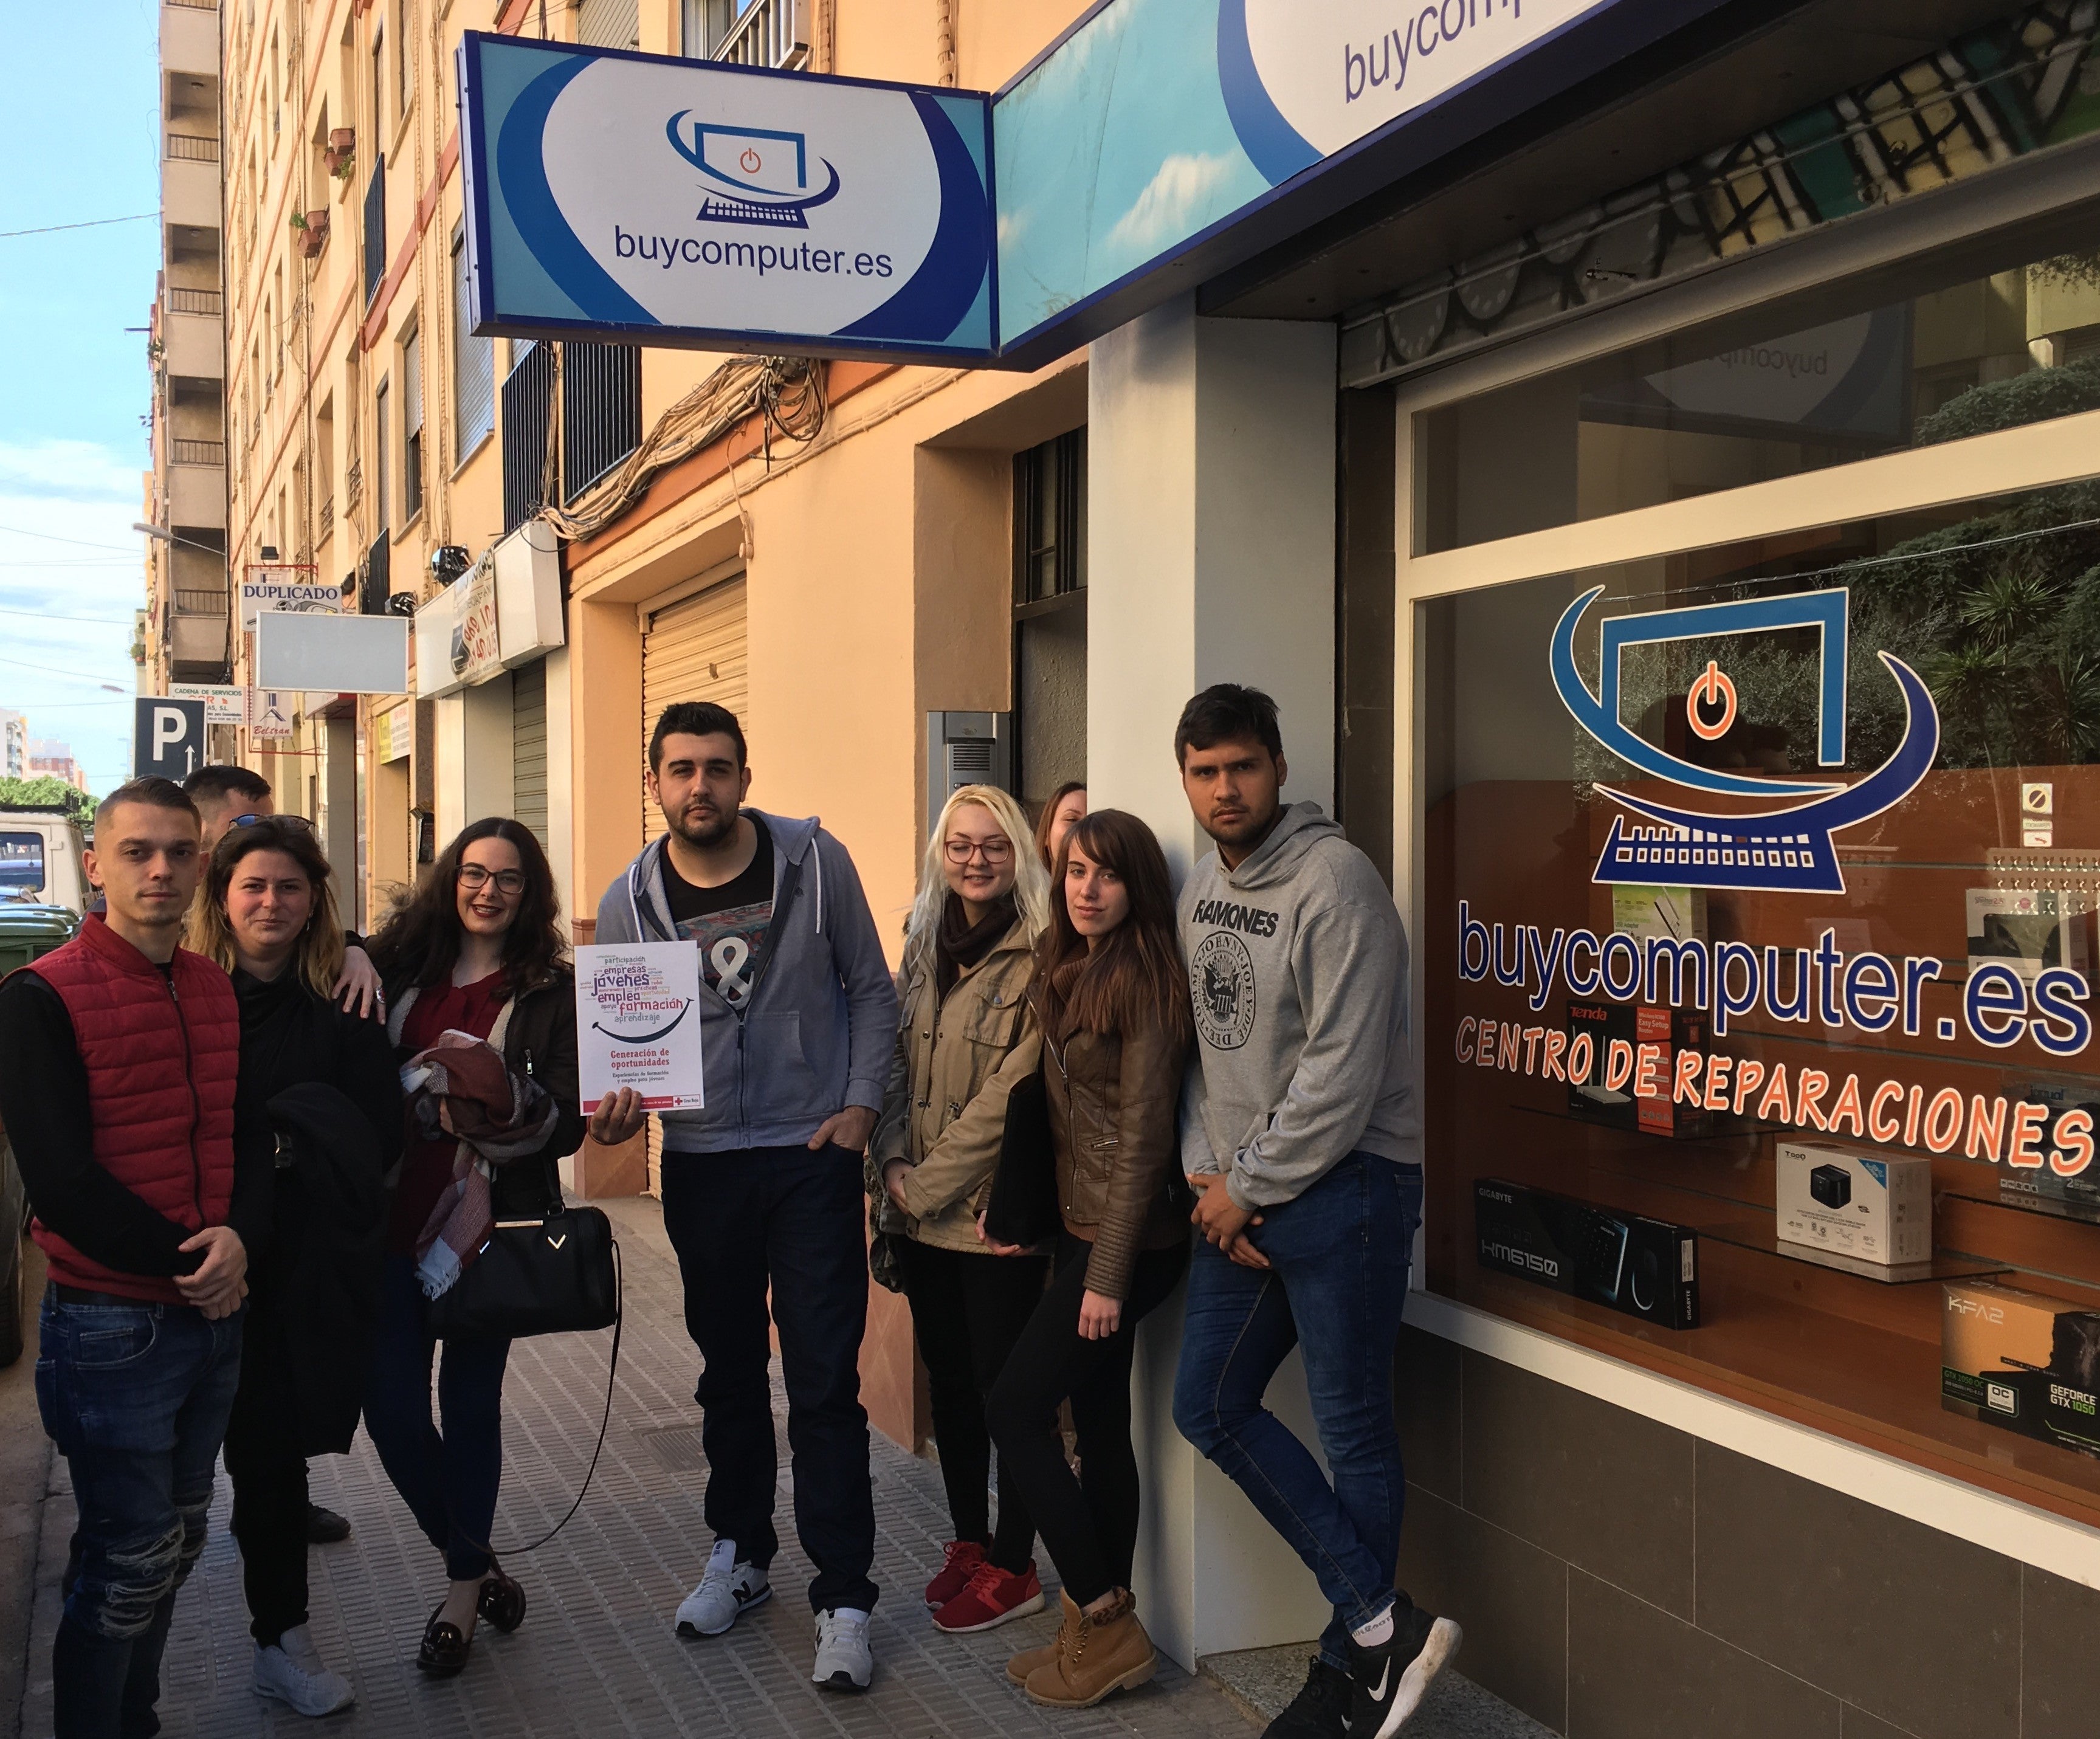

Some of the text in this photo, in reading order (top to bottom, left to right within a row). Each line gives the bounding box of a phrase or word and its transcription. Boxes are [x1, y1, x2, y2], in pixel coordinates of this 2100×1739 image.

[615, 225, 893, 277] buycomputer.es
[244, 585, 338, 600] DUPLICADO
[153, 706, 187, 761] P
[1192, 900, 1279, 938] RAMONES
[604, 956, 645, 965] participación
[604, 966, 646, 976] empresas
[1200, 935, 1244, 959] JOHNNY
[1241, 962, 1253, 1008] JOEY
[1459, 900, 2093, 1056] buycomputer.es
[591, 973, 650, 996] jóvenes
[597, 988, 641, 1005] empleo
[619, 997, 683, 1016] formación
[1570, 1006, 1608, 1022] Tenda
[615, 1012, 661, 1024] aprendizaje
[1639, 1018, 1668, 1030] Easy Setup
[611, 1048, 670, 1059] Generación de
[611, 1058, 670, 1070] oportunidades
[1456, 1015, 2096, 1177] CENTRO DE REPARACIONES
[1478, 1187, 1512, 1204] GIGABYTE
[1481, 1239, 1558, 1277] KM6150
[1949, 1296, 2005, 1325] KFA2
[1992, 1386, 2010, 1399] OC
[2050, 1383, 2096, 1406] GEFORCE
[2050, 1394, 2096, 1415] GTX 1050
